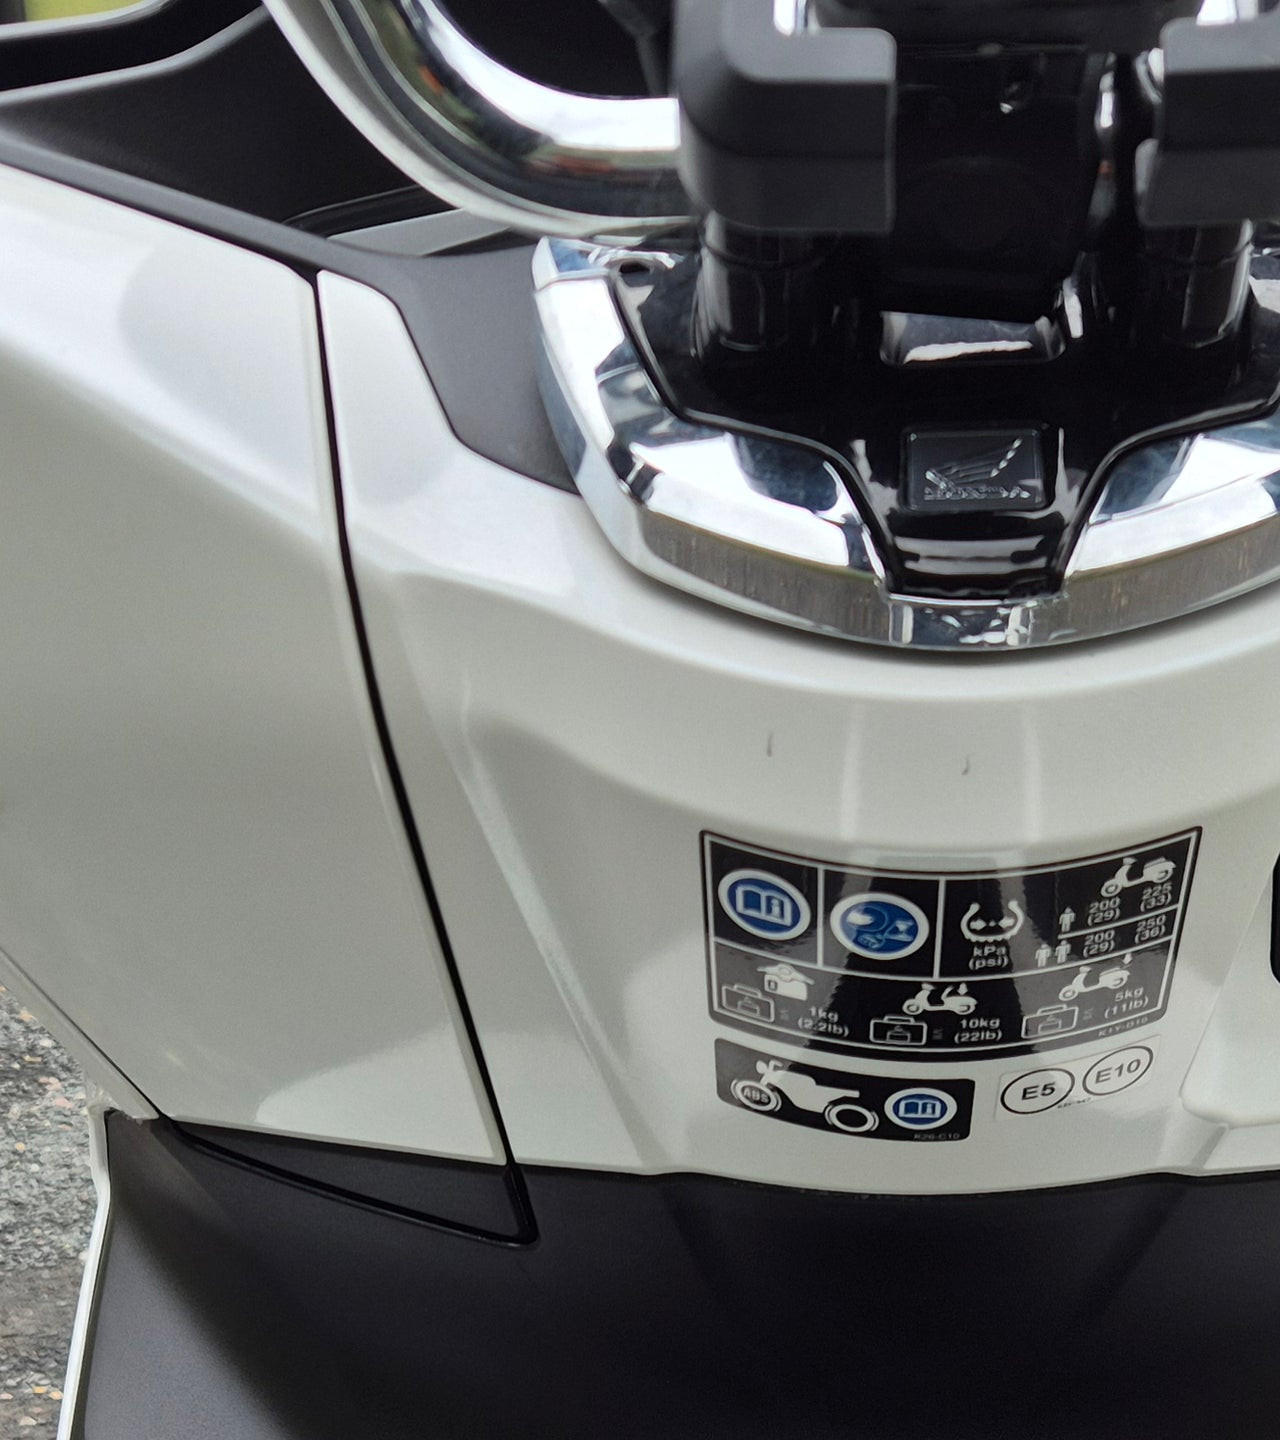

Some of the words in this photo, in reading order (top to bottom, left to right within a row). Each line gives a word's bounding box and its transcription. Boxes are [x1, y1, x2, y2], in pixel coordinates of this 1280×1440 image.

[1141, 881, 1172, 900] 225
[1089, 896, 1120, 914] 200
[1140, 893, 1172, 912] (33)
[1087, 908, 1120, 927] (29)
[1136, 914, 1166, 932] 250
[1084, 929, 1115, 946] 200
[973, 945, 1006, 957] kPa
[1082, 940, 1115, 958] (29)
[969, 955, 1008, 970] (psi)
[1115, 987, 1144, 1002] 5kg
[810, 1006, 839, 1023] 1kg
[961, 1018, 1000, 1029] 10kg
[798, 1017, 849, 1037] (2.2lb)
[954, 1030, 1002, 1043] (22lb)
[1095, 1059, 1141, 1084] E10
[1021, 1082, 1056, 1100] E5
